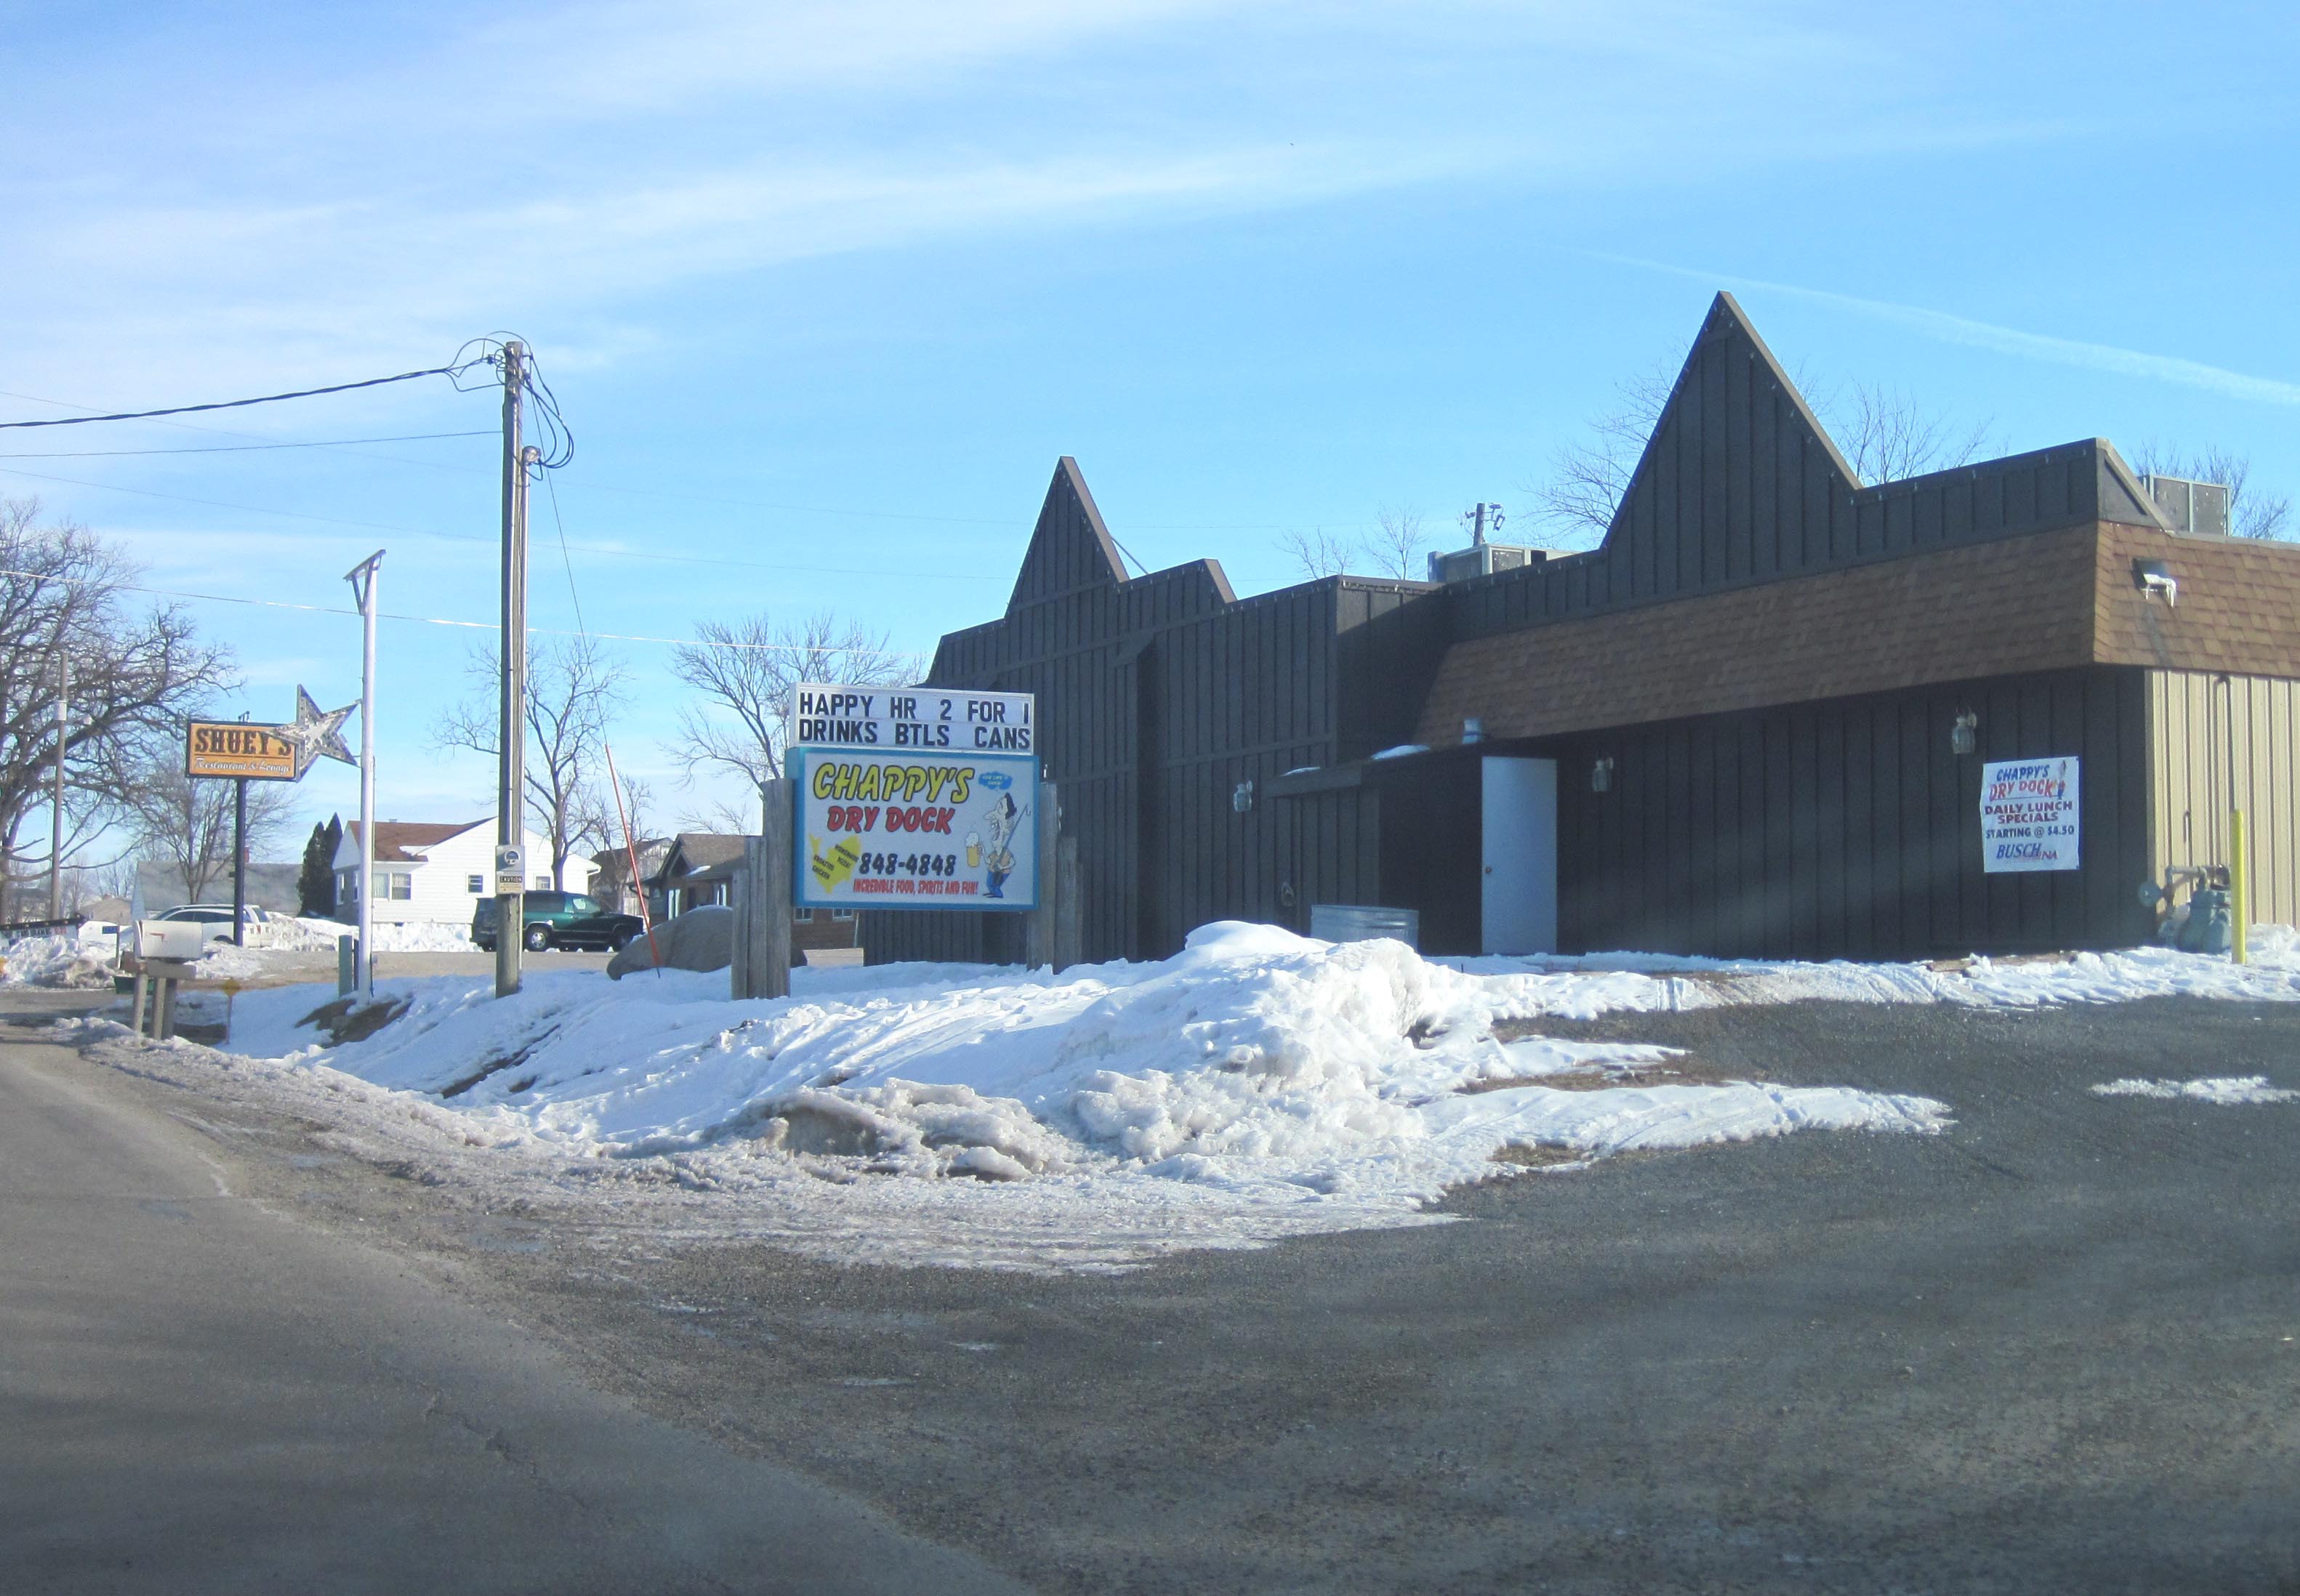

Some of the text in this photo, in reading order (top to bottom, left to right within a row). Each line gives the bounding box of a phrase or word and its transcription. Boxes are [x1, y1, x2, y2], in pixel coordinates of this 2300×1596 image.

[800, 692, 874, 717] HAPPY
[890, 696, 917, 720] HR
[940, 699, 952, 721] 2
[968, 700, 1005, 723] FOR
[800, 719, 1031, 749] DRINKS BTLS CANS
[196, 757, 246, 770] Restaurant
[257, 760, 290, 774] Lounge
[1996, 765, 2050, 781] CHAPPY'S
[813, 762, 975, 804] CHAPPY'S
[1989, 779, 2054, 801] DRY DOCK
[1985, 801, 2072, 815] DAILY LUNCH
[827, 805, 955, 834] DRY DOCK
[1998, 812, 2059, 824] SPECIALS
[1985, 825, 2075, 839] STARTING @ $4.50
[1996, 843, 2042, 859] BUSCH
[859, 853, 957, 876] 848-4848
[853, 878, 979, 895] INCREDIBLE FOOD, SPIRITS AND FUN!
